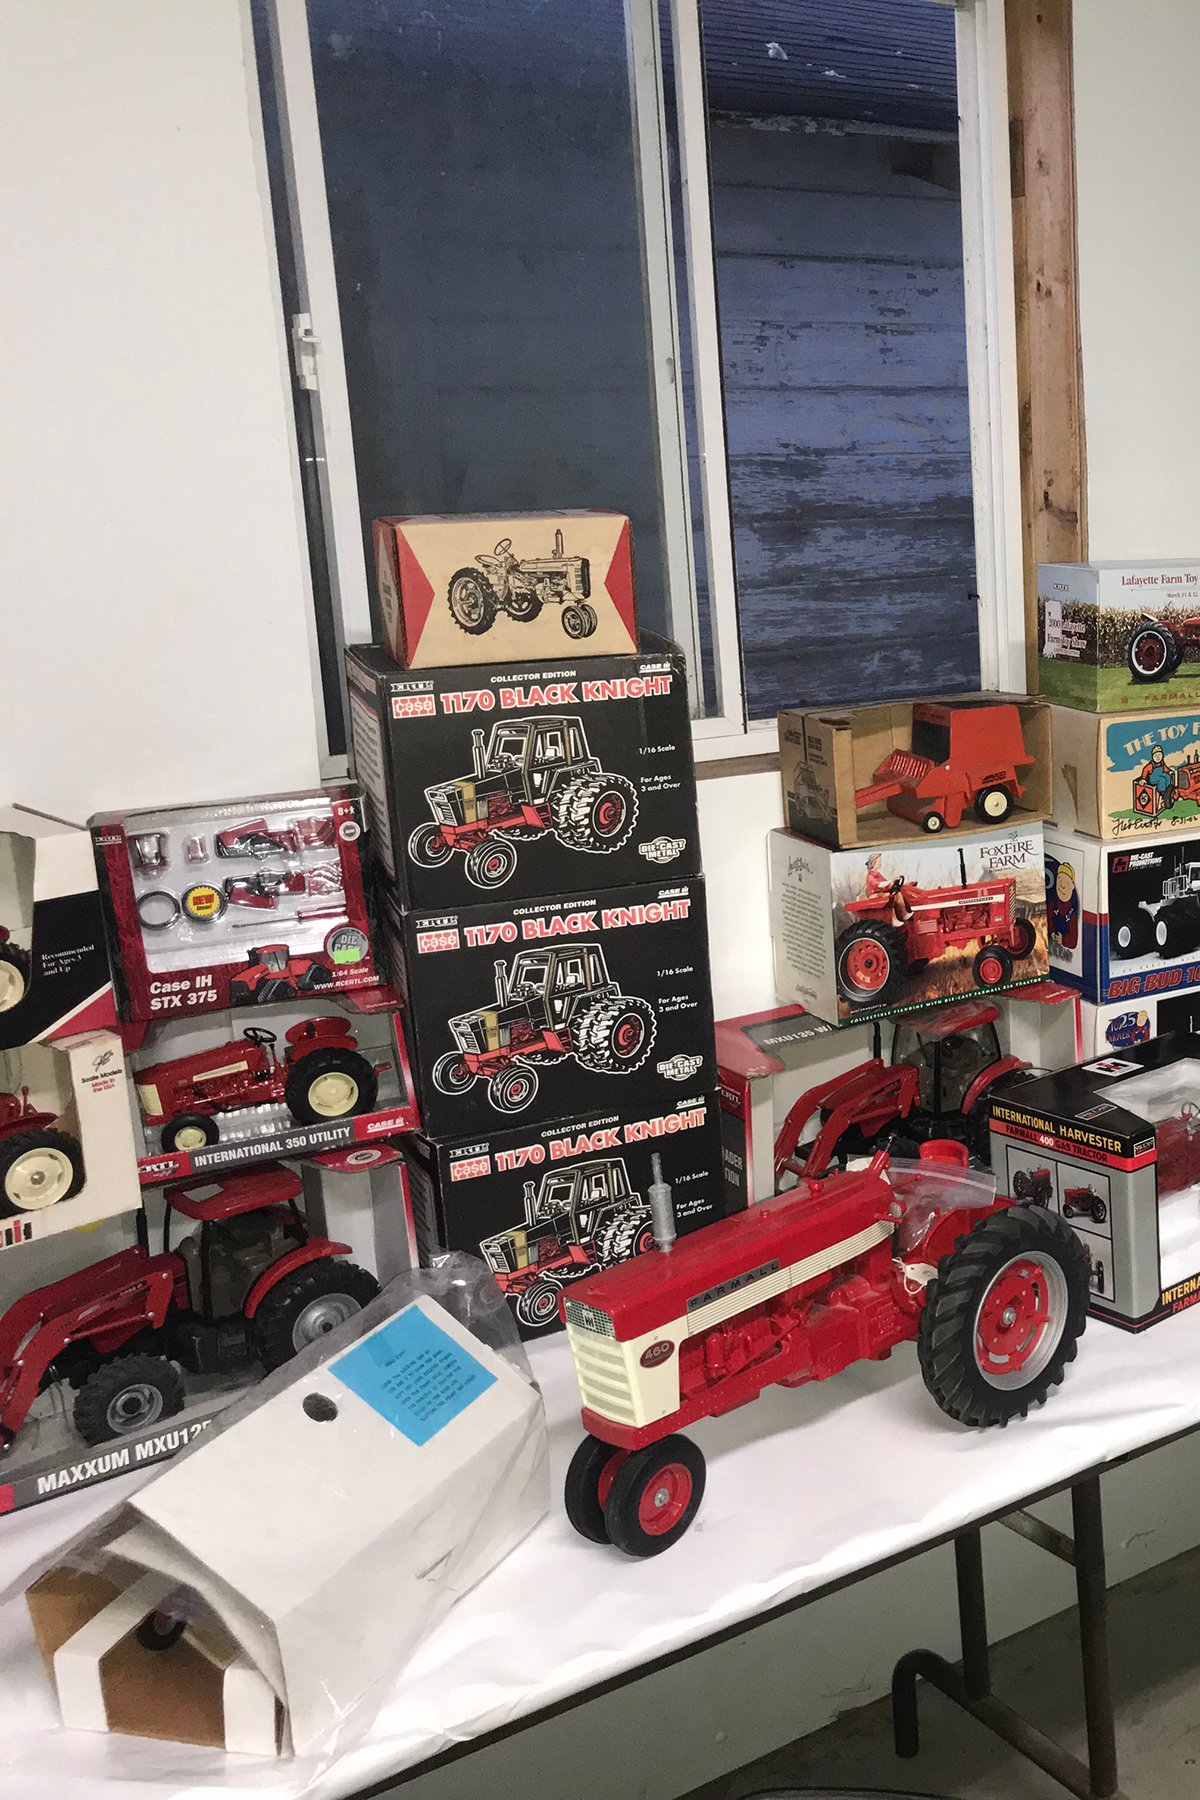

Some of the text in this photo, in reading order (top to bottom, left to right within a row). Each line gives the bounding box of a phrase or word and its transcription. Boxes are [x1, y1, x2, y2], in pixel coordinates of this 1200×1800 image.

[1121, 575, 1159, 588] Lafayette
[1161, 573, 1183, 584] Farm
[1184, 573, 1198, 586] Toy
[491, 670, 577, 684] COLLECTOR EDITION
[440, 675, 673, 715] 1170 BLACK KNIGHT
[639, 744, 676, 755] 1/16 Scale
[1123, 730, 1157, 757] THE
[1158, 722, 1189, 742] TOY
[640, 774, 672, 784] For Ages
[647, 783, 662, 791] and
[663, 781, 681, 790] Over
[979, 840, 1035, 860] FOXFIRE
[988, 852, 1026, 870] FARM
[513, 899, 597, 916] COLLECTOR EDITION
[464, 899, 691, 949] 1170 BLACK KNIGHT
[341, 935, 357, 944] DIE
[419, 931, 459, 951] case
[41, 944, 95, 961] Recommended
[42, 960, 56, 969] For
[59, 957, 76, 967] Ages
[44, 966, 71, 977] and Up
[349, 967, 369, 976] Scale
[150, 974, 213, 995] Case IH
[1108, 976, 1141, 1000] BIG
[1144, 967, 1183, 992] BUD
[150, 989, 218, 1011] STX 375
[1121, 1013, 1136, 1029] 25
[81, 1068, 123, 1084] Scale Models
[541, 1114, 619, 1139] COLLECTOR EDITION
[992, 1105, 1056, 1134] INTERNATIONAL
[1059, 1126, 1122, 1153] HARVESTER
[195, 1127, 351, 1168] INTERNATIONAL 350 UTILITY
[495, 1107, 707, 1172] 1170 BLACK KNIGHT
[1005, 1124, 1108, 1163] FARMALL 400 GAS TRACTOR
[689, 1260, 780, 1309] FARMALL
[644, 1341, 670, 1361] 460
[37, 1448, 130, 1495] MAXXUM
